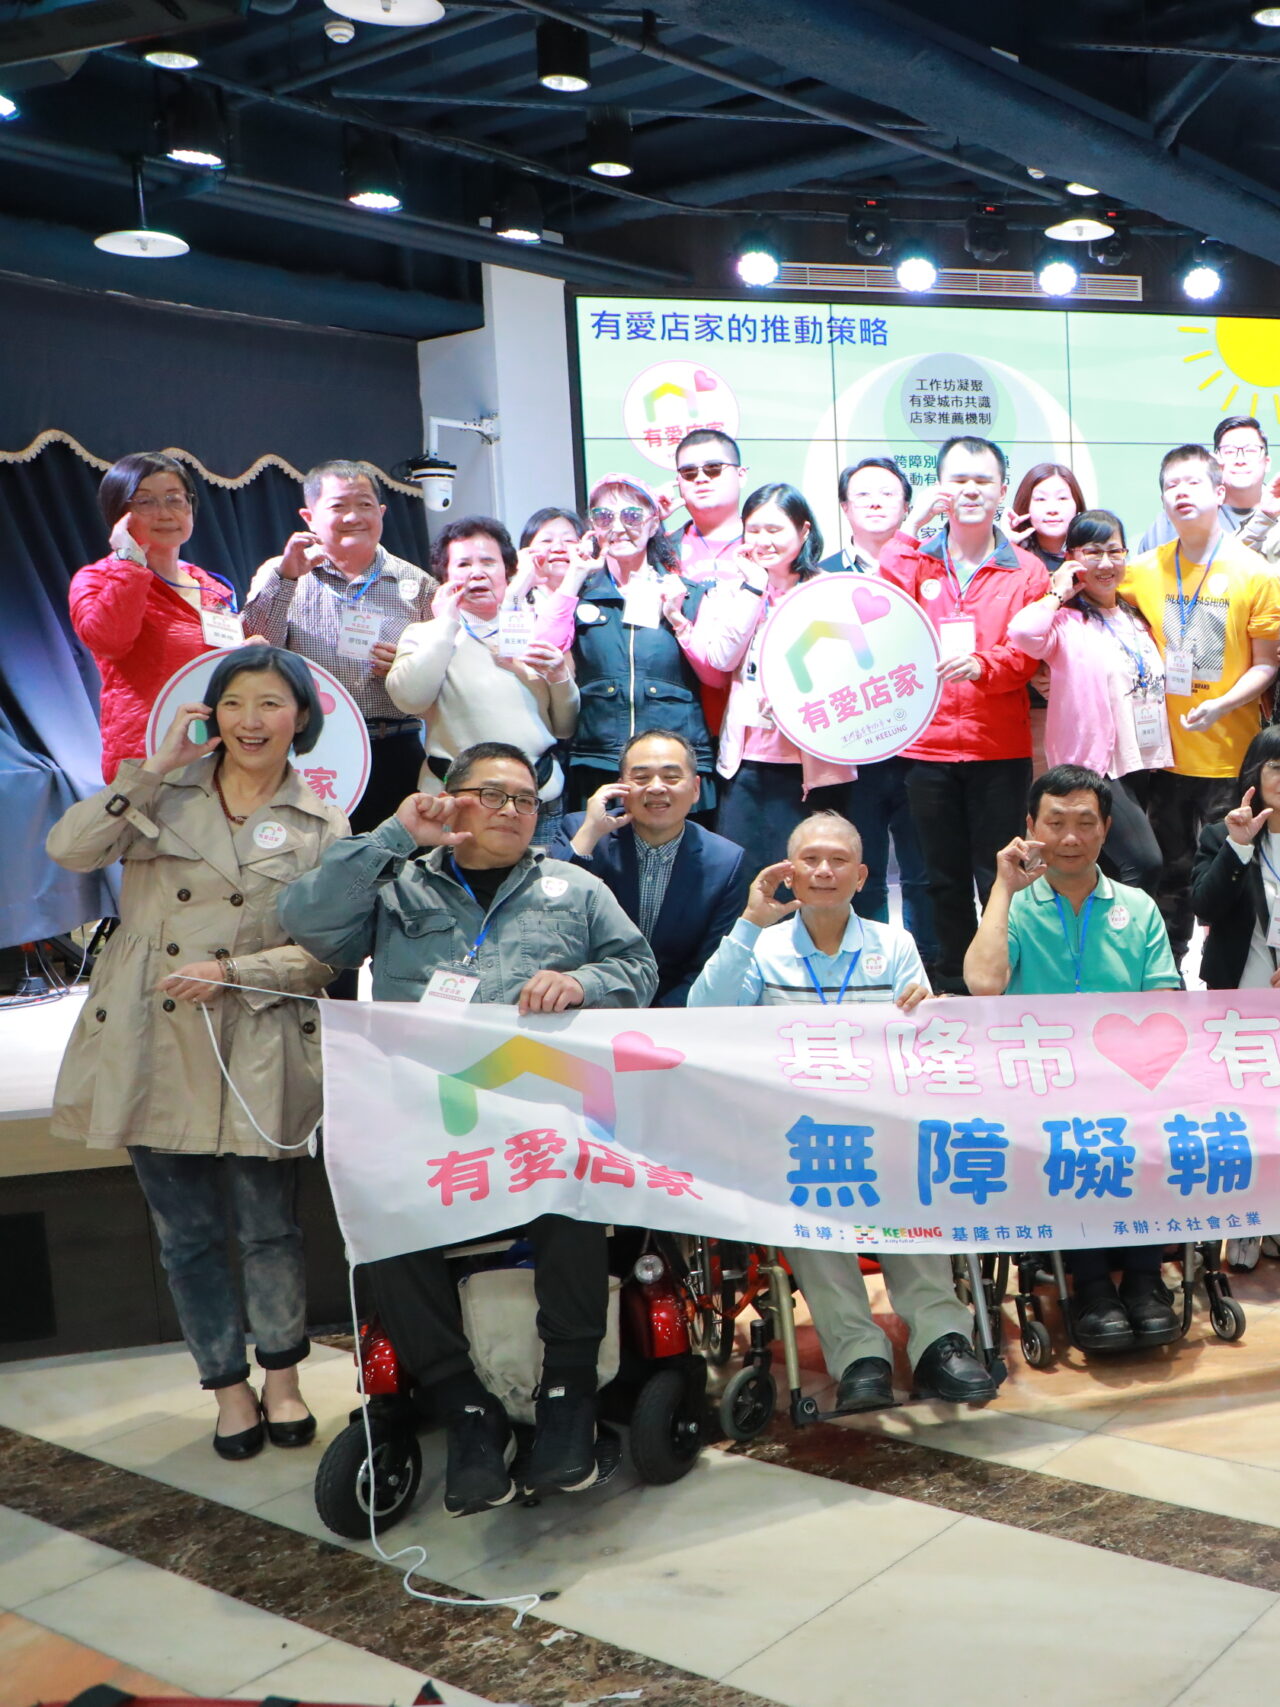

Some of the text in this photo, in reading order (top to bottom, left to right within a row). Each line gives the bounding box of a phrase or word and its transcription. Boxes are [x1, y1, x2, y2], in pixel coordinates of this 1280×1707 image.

[589, 309, 889, 347] 有愛店家的推動策略
[915, 378, 984, 392] 工作坊凝聚
[909, 394, 992, 409] 有愛城市共識
[909, 411, 992, 425] 店家推薦機制
[797, 663, 925, 733] 有愛店家
[776, 1012, 1077, 1096] 基隆市
[426, 1127, 704, 1207] 有愛店家
[882, 1226, 943, 1239] KEELUNG
[951, 1224, 1054, 1243] 基隆市政府
